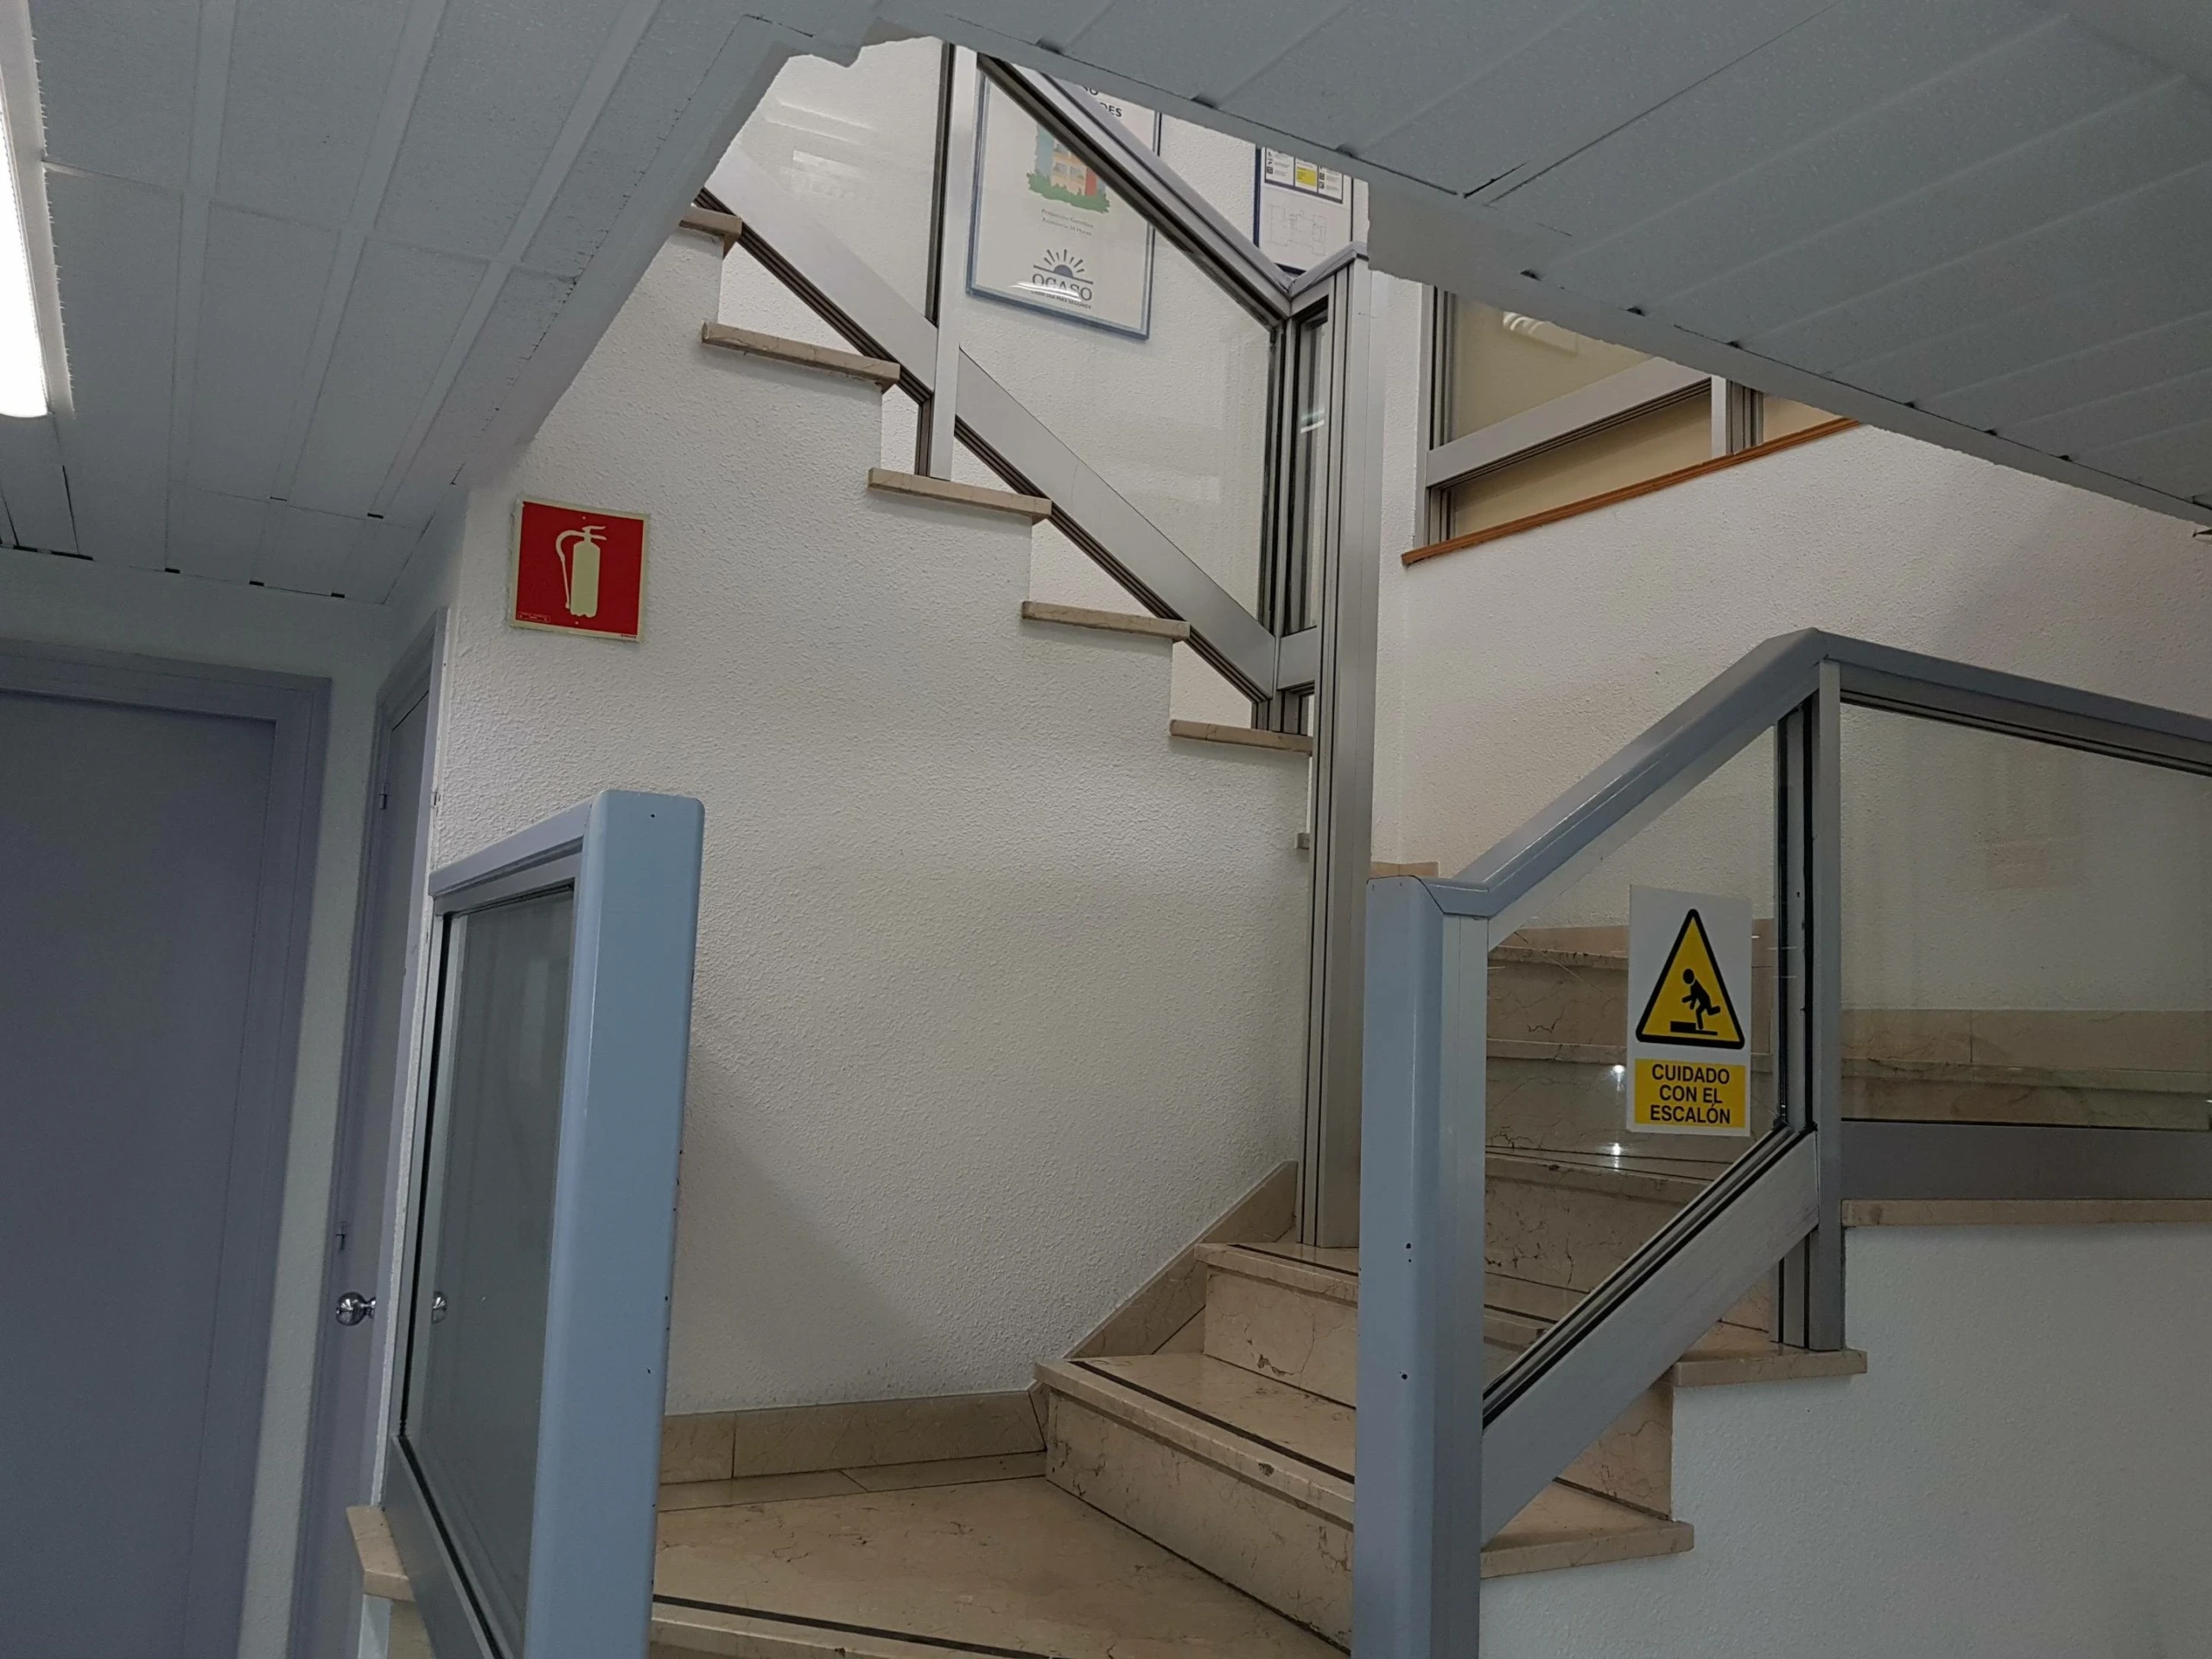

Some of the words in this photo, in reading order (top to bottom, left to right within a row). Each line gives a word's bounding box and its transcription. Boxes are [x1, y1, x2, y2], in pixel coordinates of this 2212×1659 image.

[1032, 273, 1092, 301] OCASO
[1652, 1064, 1730, 1084] CUIDADO
[1660, 1084, 1697, 1102] CON
[1703, 1087, 1723, 1103] EL
[1650, 1103, 1731, 1124] ESCALÓN
